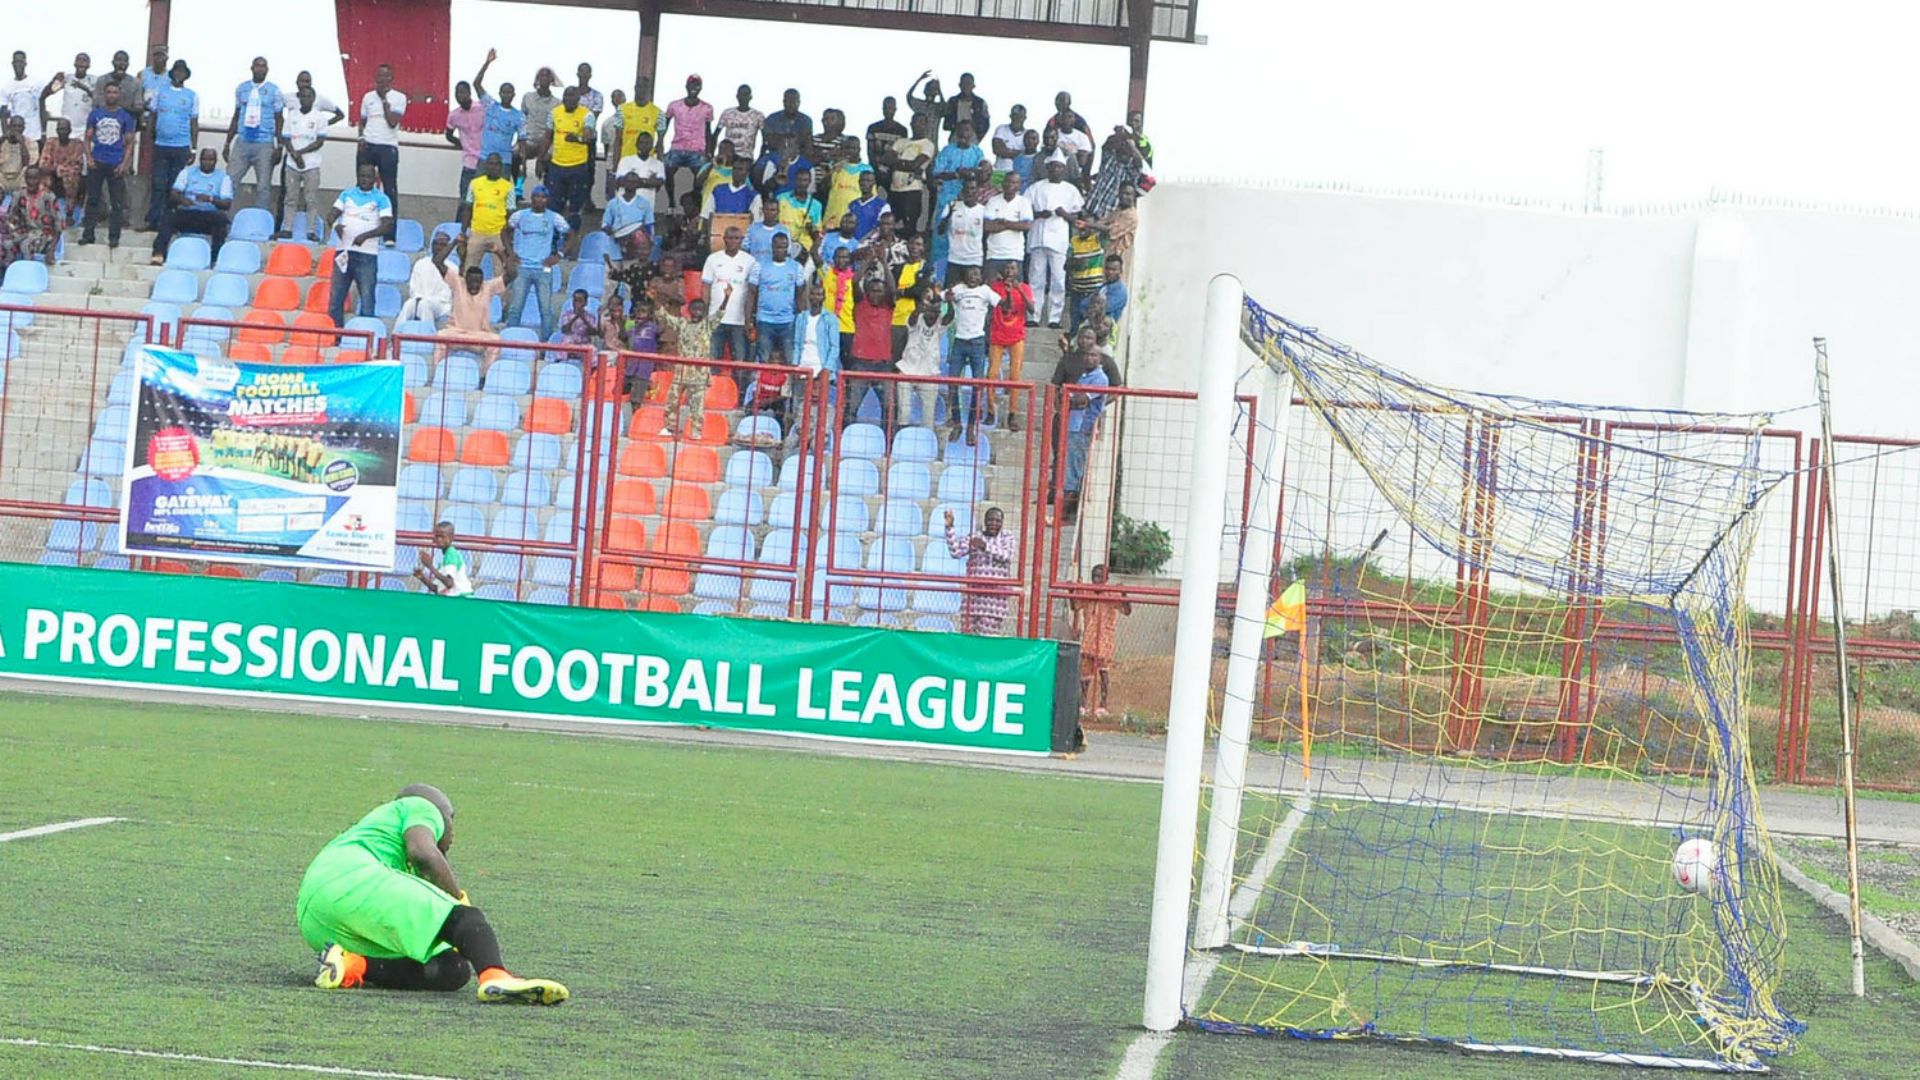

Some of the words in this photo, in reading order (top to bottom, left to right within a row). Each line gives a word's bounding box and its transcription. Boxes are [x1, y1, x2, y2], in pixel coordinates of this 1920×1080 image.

[254, 373, 304, 385] HOME
[236, 382, 320, 398] FOOTBALL
[228, 396, 327, 416] MATCHES
[155, 495, 231, 509] GATEWAY
[24, 609, 459, 692] PROFESSIONAL
[479, 643, 776, 717] FOOTBALL
[796, 667, 1026, 736] LEAGUE
